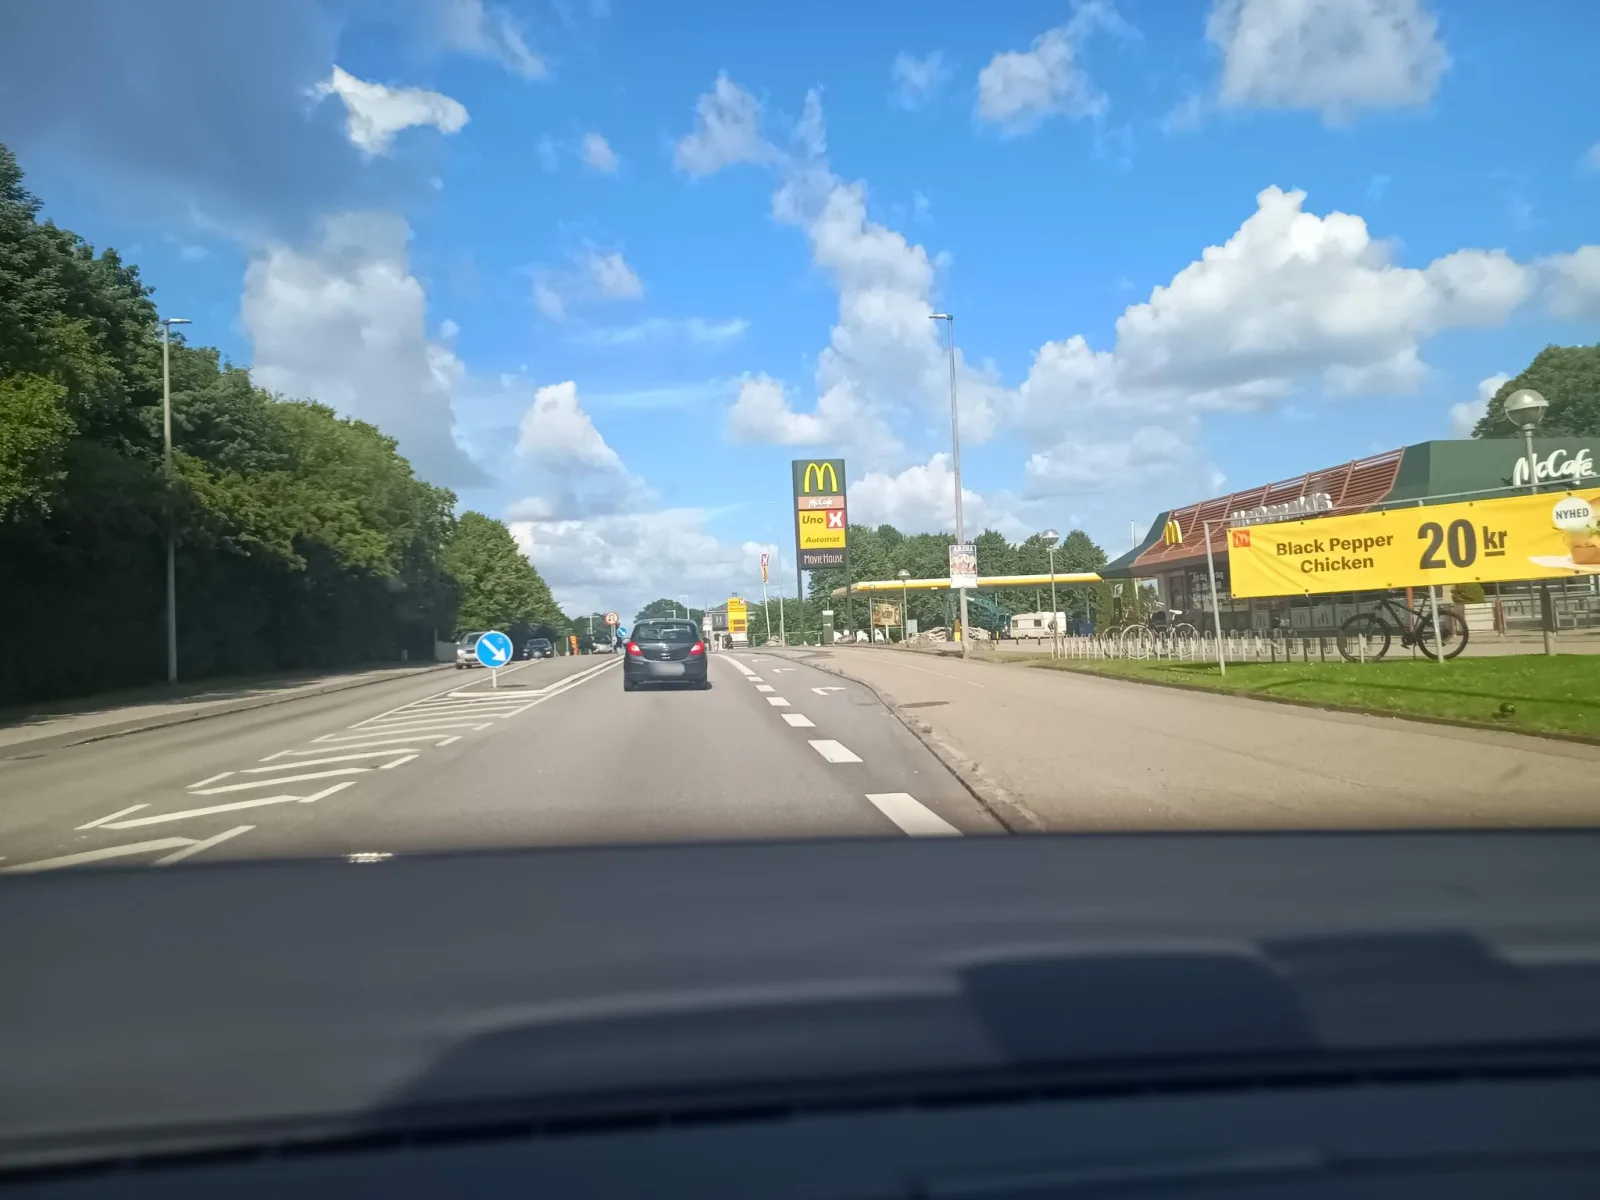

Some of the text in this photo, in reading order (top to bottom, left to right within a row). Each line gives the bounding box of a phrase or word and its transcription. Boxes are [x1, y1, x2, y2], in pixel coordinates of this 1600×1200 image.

[802, 511, 843, 528] Uno X
[1555, 507, 1590, 520] NYHED
[805, 536, 840, 544] Automat
[1276, 533, 1394, 556] Black Pepper
[1417, 518, 1508, 570] 20 kr
[1300, 556, 1374, 573] Chicken
